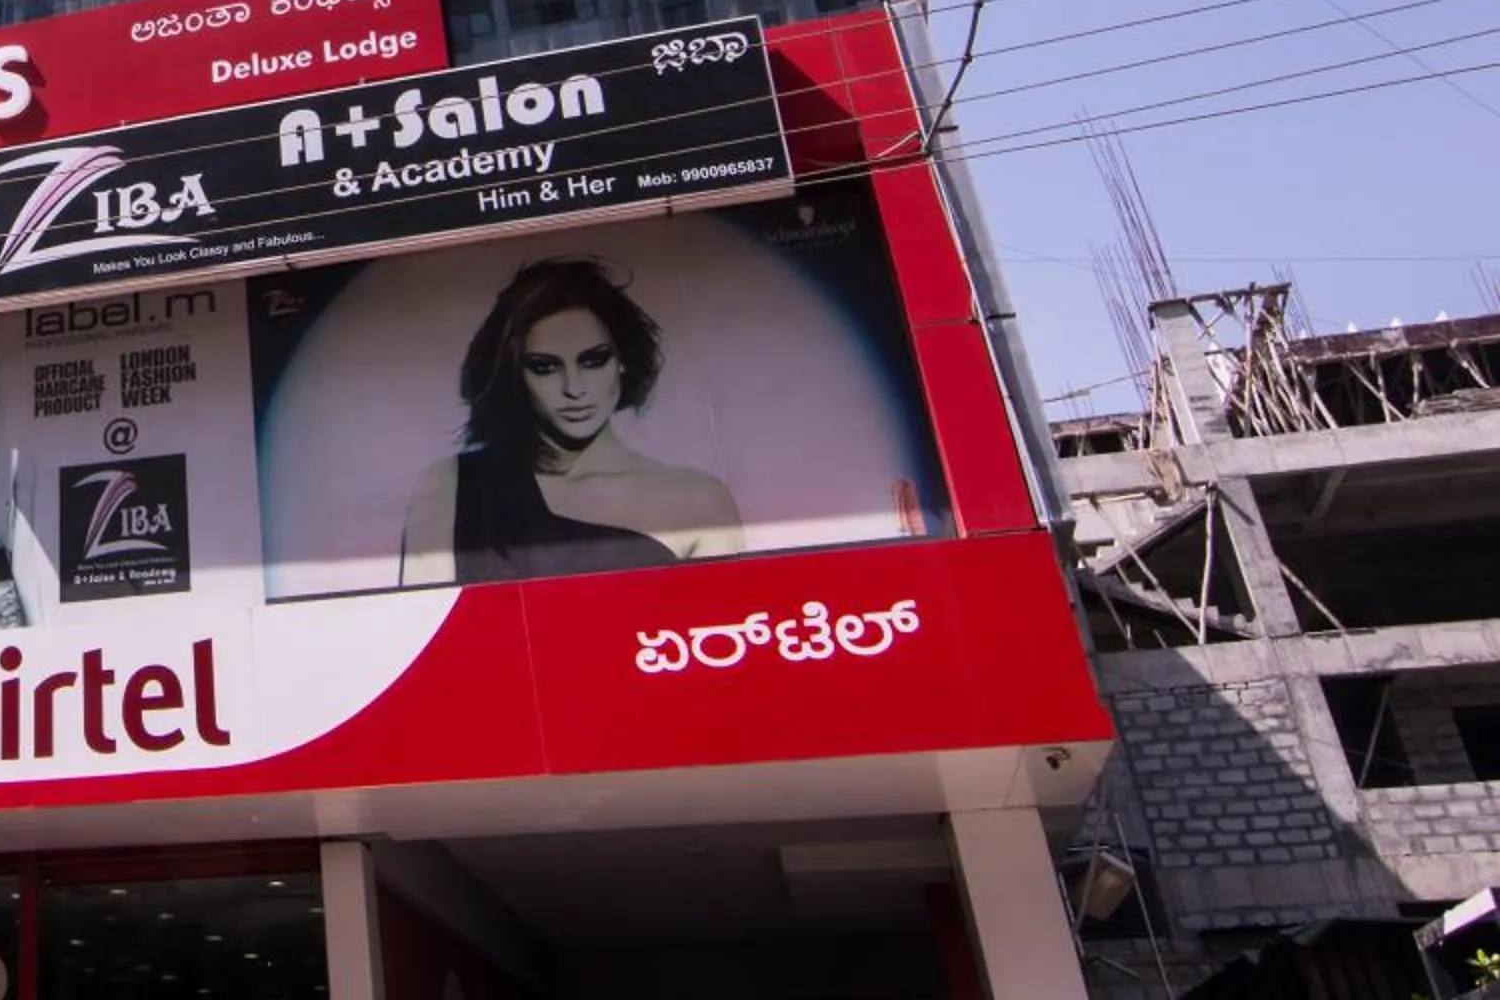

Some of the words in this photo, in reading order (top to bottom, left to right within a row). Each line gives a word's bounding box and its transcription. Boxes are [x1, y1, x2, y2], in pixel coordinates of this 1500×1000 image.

[130, 1, 250, 42] ಅಜಂತಾ
[211, 49, 312, 83] Deluxe
[323, 29, 417, 63] Lodge
[332, 167, 361, 198] &
[370, 140, 556, 192] Academy
[637, 172, 678, 189] Mob:
[681, 157, 774, 183] 9900965837
[478, 187, 531, 212] Him
[539, 180, 560, 202] &
[566, 175, 617, 198] Her
[93, 259, 130, 276] Makes
[132, 253, 157, 270] You
[158, 248, 187, 265] Look
[189, 242, 229, 260] Classy
[232, 239, 255, 254] and
[25, 289, 217, 338] label.m
[34, 359, 96, 383] OFFICIAL
[120, 345, 190, 371] LONDON
[34, 374, 106, 399] HAIRCARE
[121, 362, 197, 389] FASHION
[34, 393, 102, 418] PRODUCT
[121, 385, 172, 409] WEEK
[103, 417, 138, 455] @
